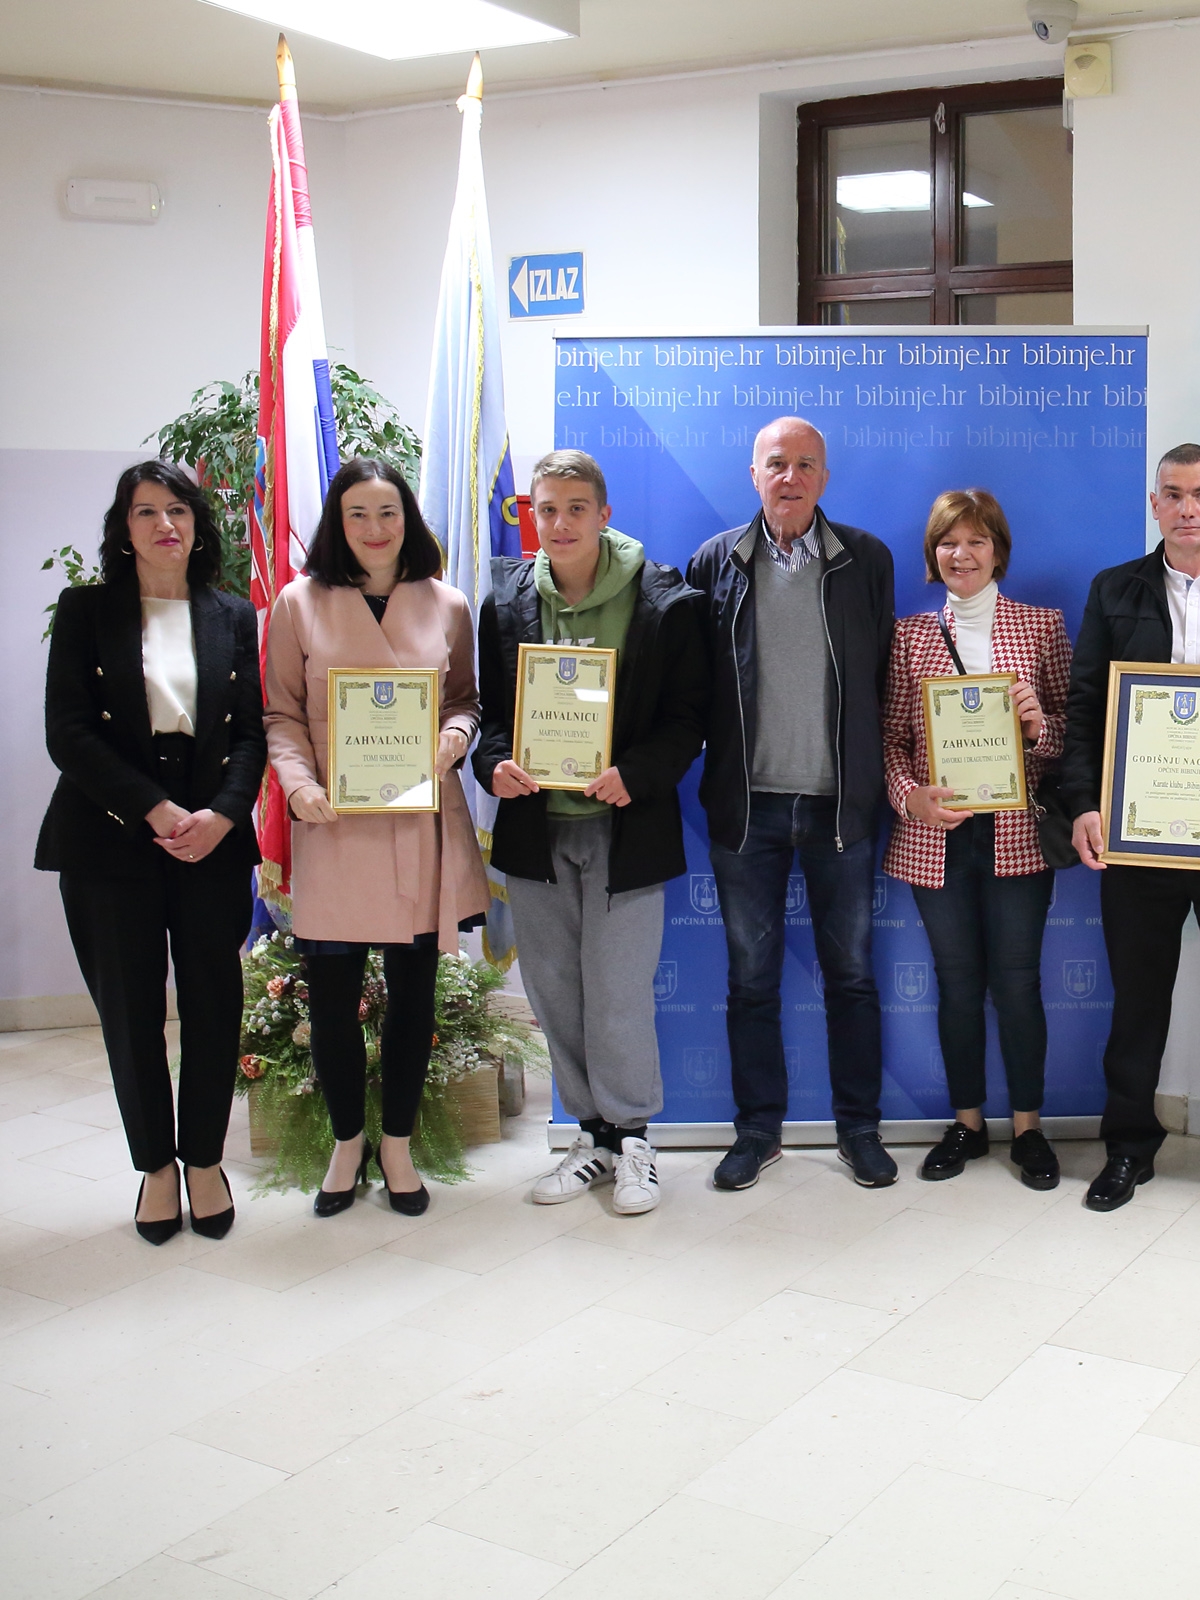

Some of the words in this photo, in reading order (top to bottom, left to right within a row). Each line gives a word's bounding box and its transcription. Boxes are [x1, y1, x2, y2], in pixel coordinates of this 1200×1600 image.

[529, 267, 579, 302] IZLAZ
[556, 344, 643, 373] binje.hr
[653, 344, 764, 373] bibinje.hr
[775, 343, 887, 372] bibinje.hr
[898, 343, 1011, 372] bibinje.hr
[1022, 343, 1136, 372] bibinje.hr
[613, 385, 722, 413] bibinje.hr
[733, 384, 844, 412] bibinje.hr
[855, 384, 967, 412] bibinje.hr
[979, 384, 1092, 412] bibinje.hr
[601, 425, 709, 453] bibinje.hr
[843, 425, 954, 453] bibinje.hr
[966, 425, 1079, 453] bibinje.hr
[531, 709, 599, 723] ZAHVALNICU
[345, 735, 422, 746] ZAHVALNICU
[942, 736, 1008, 749] ZAHVALNICU
[363, 754, 378, 762] TOMI
[1132, 754, 1180, 765] GODIŠNJU
[671, 915, 706, 926] OPĆINA
[790, 917, 812, 926] BIBI
[1046, 917, 1075, 927] IBINJE
[795, 1002, 826, 1012] OPĆIN
[912, 1004, 938, 1013] BIBIN
